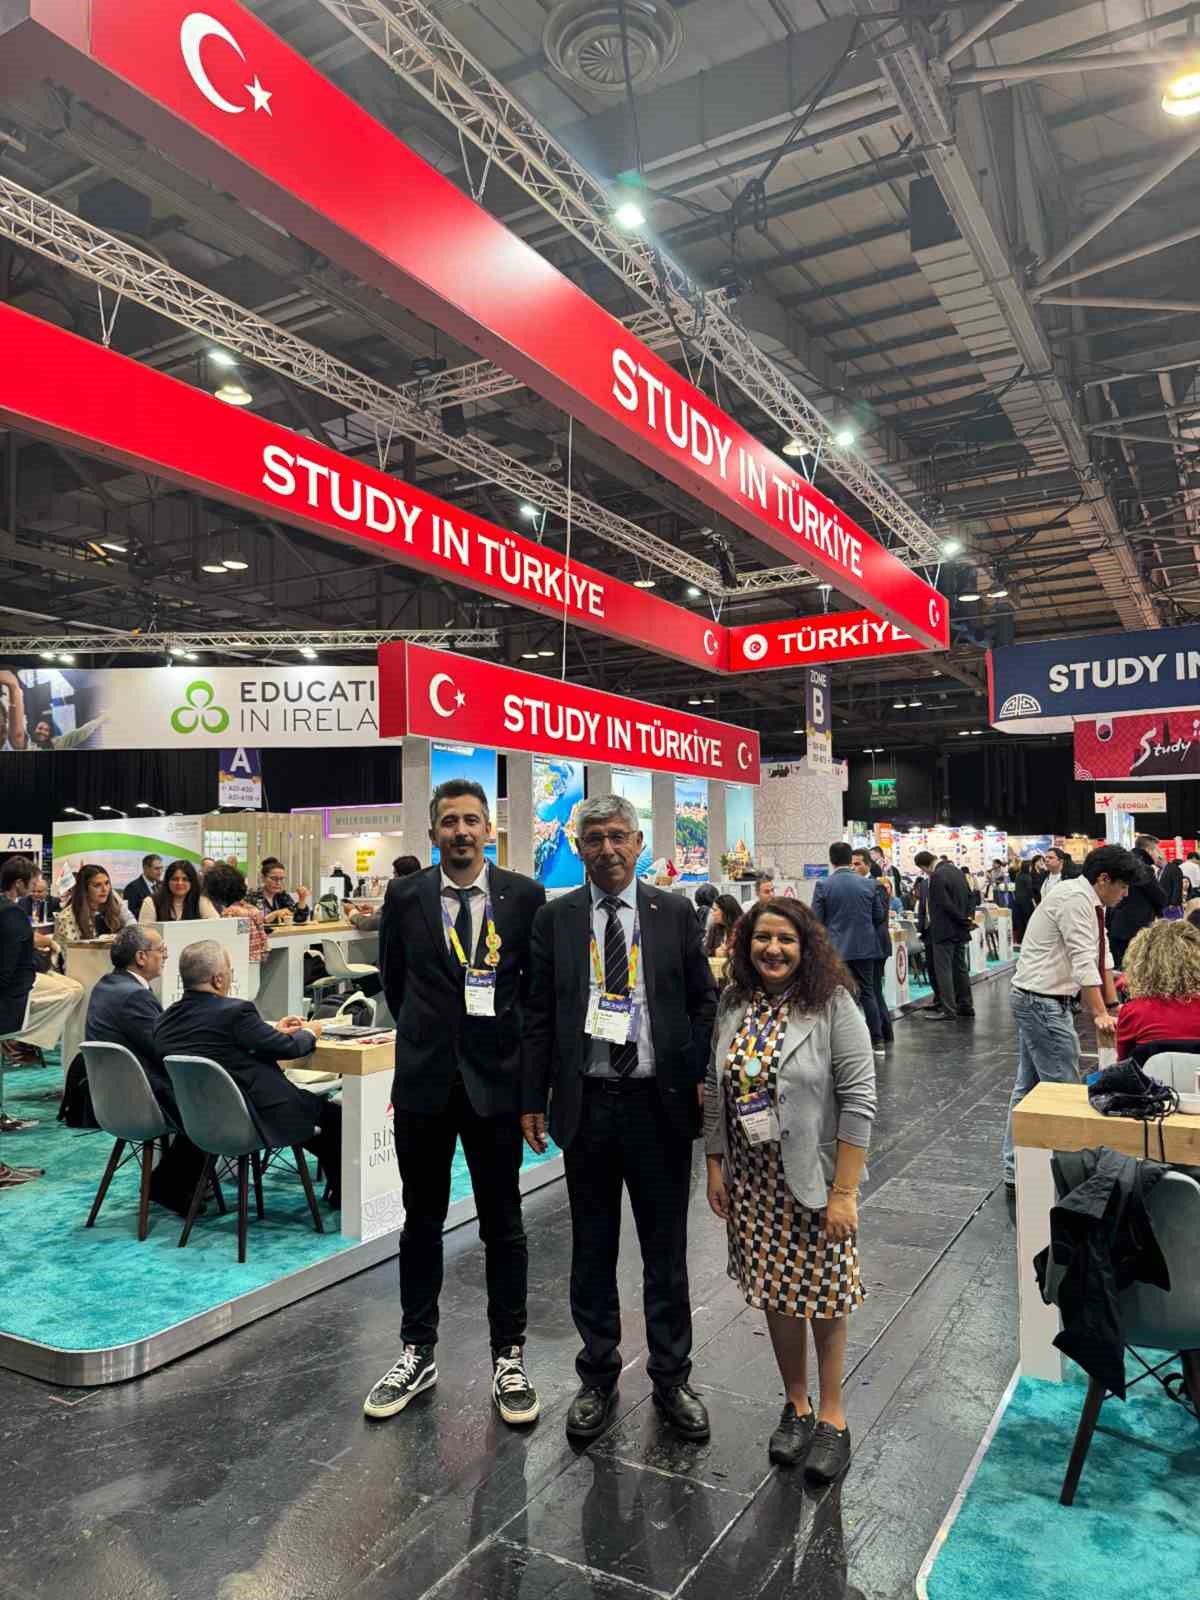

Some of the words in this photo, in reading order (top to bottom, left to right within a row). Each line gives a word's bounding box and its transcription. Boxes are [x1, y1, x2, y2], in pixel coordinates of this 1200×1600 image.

[612, 349, 732, 479] STUDY
[740, 448, 767, 509] IN
[772, 475, 863, 579] TÜRKİYE
[262, 445, 423, 543] STUDY
[432, 514, 469, 566] IN
[477, 533, 605, 618] TÜRKİYE
[1049, 653, 1167, 693] STUDY
[240, 708, 269, 732] IN
[812, 687, 825, 725] B
[503, 694, 601, 745] STUDY
[607, 716, 632, 751] IN
[636, 720, 723, 767] TÜRKİYE
[1129, 727, 1192, 772] Study
[230, 747, 252, 774] A
[8, 836, 33, 849] A14
